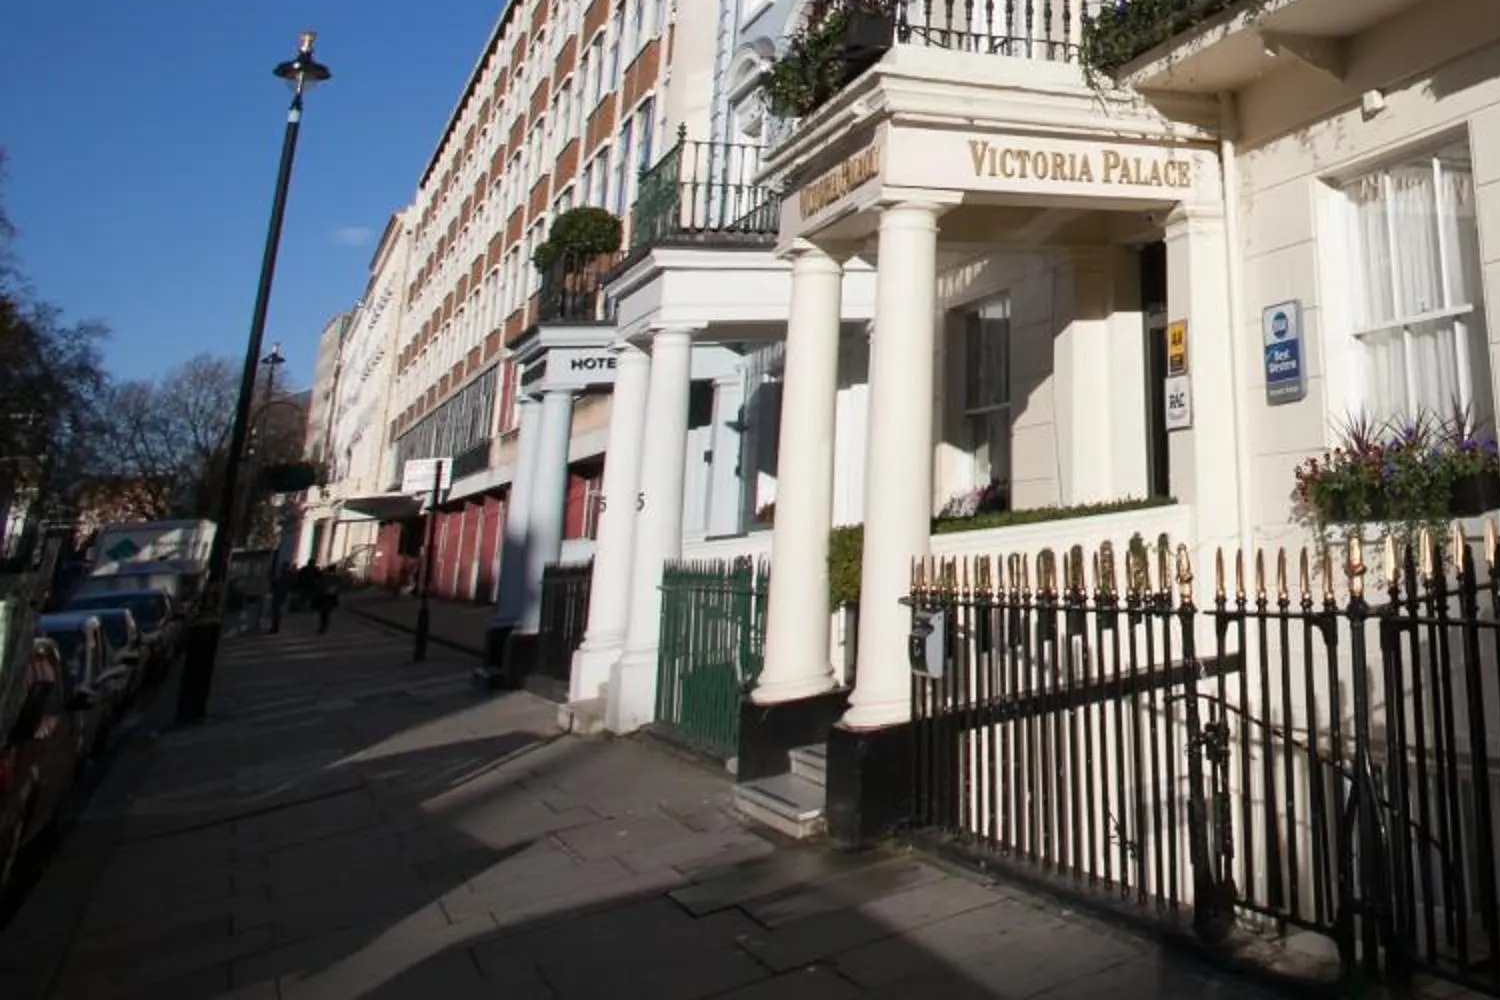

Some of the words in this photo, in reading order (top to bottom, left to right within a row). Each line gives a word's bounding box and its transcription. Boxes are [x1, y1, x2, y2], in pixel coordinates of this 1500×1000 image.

[968, 139, 1094, 183] VICTORIA
[1102, 149, 1191, 188] PALACE
[571, 357, 617, 371] HOTE
